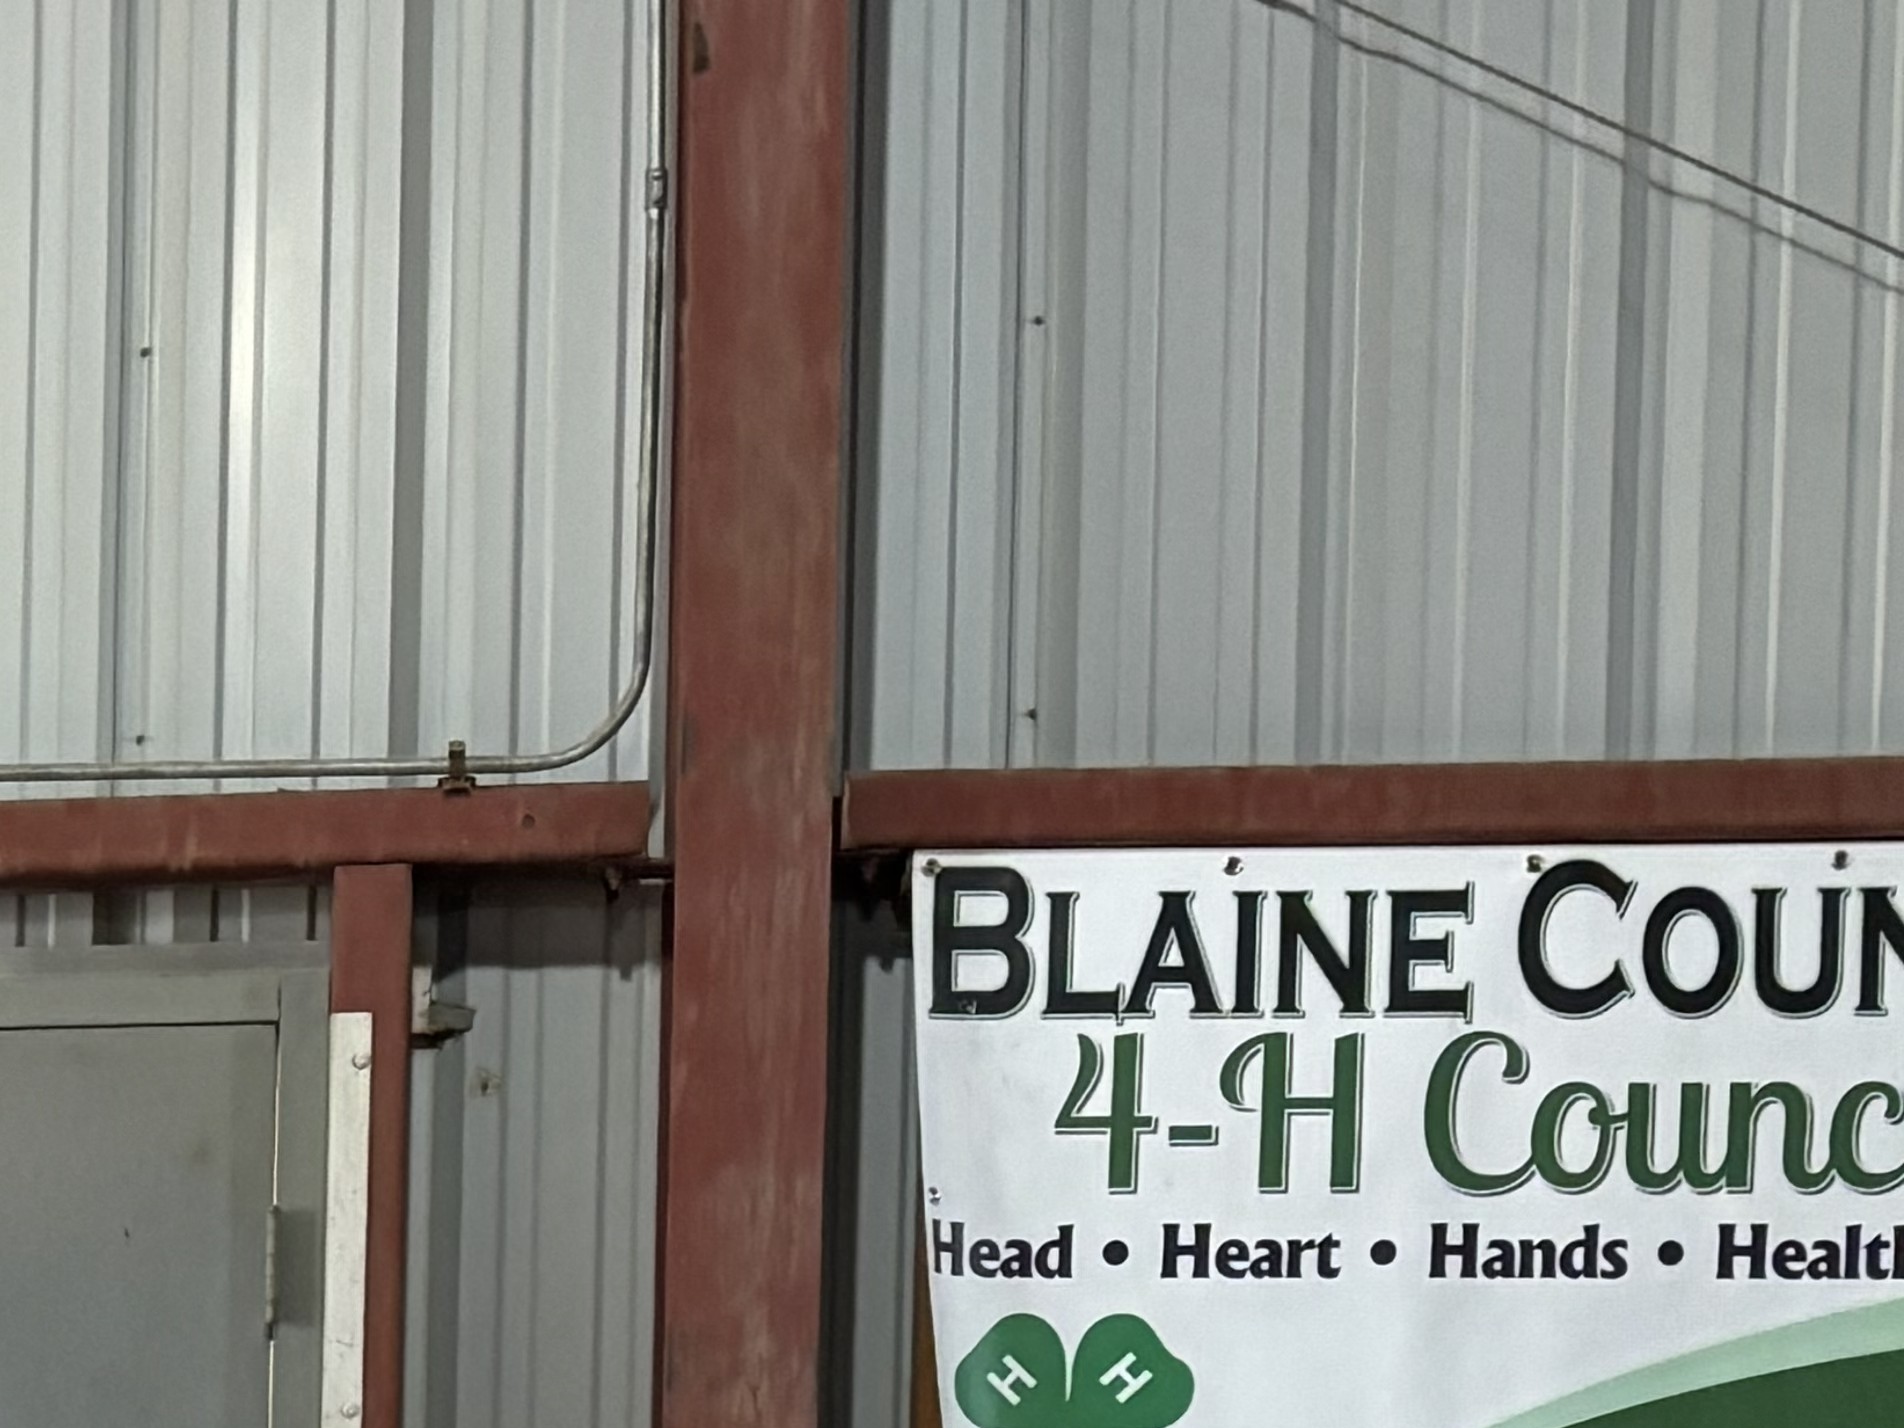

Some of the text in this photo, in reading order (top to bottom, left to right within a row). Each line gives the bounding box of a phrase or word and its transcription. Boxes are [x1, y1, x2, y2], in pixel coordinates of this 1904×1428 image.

[927, 864, 1475, 1023] BLAINE
[1054, 1030, 1366, 1196] 4-H
[932, 1219, 1074, 1279] Head
[1160, 1223, 1341, 1279] Heart
[1429, 1223, 1628, 1279] Hands
